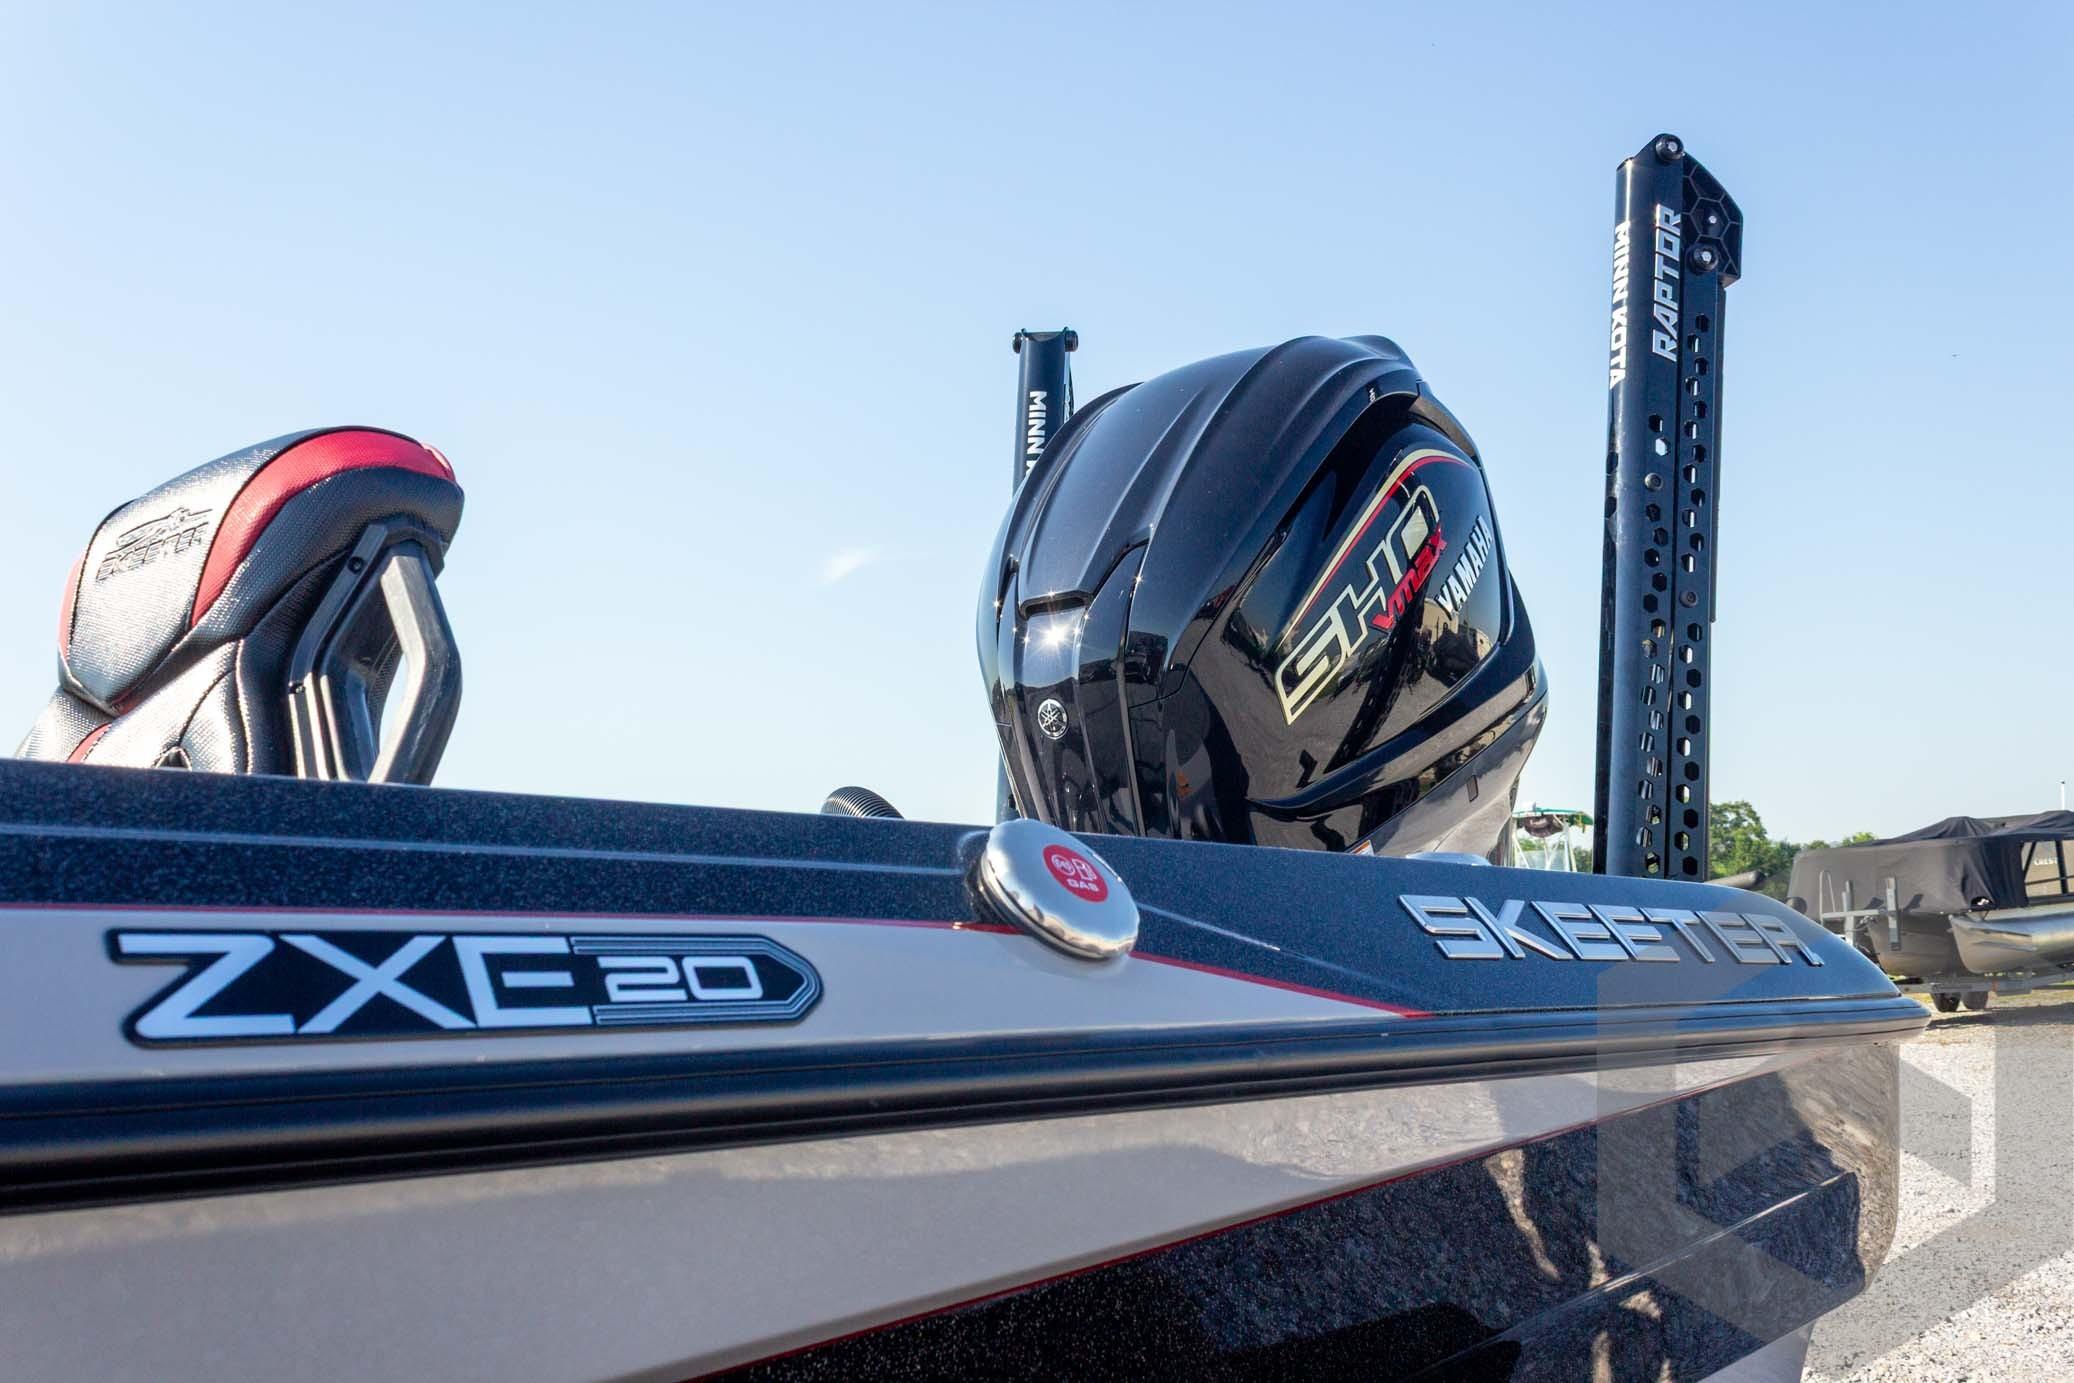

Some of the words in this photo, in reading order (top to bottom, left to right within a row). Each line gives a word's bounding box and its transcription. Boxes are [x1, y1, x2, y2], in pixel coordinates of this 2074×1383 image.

[1612, 221, 1630, 304] MINN
[1652, 203, 1681, 363] RAPTOR
[1610, 305, 1628, 390] KOTA
[1026, 390, 1048, 455] MINN
[1274, 484, 1440, 726] SHO
[1435, 514, 1493, 621] YAMAHA
[1066, 878, 1099, 892] GAS
[1399, 894, 1826, 967] SKEETER
[117, 933, 593, 1039] ZXE
[597, 955, 764, 1002] 20
